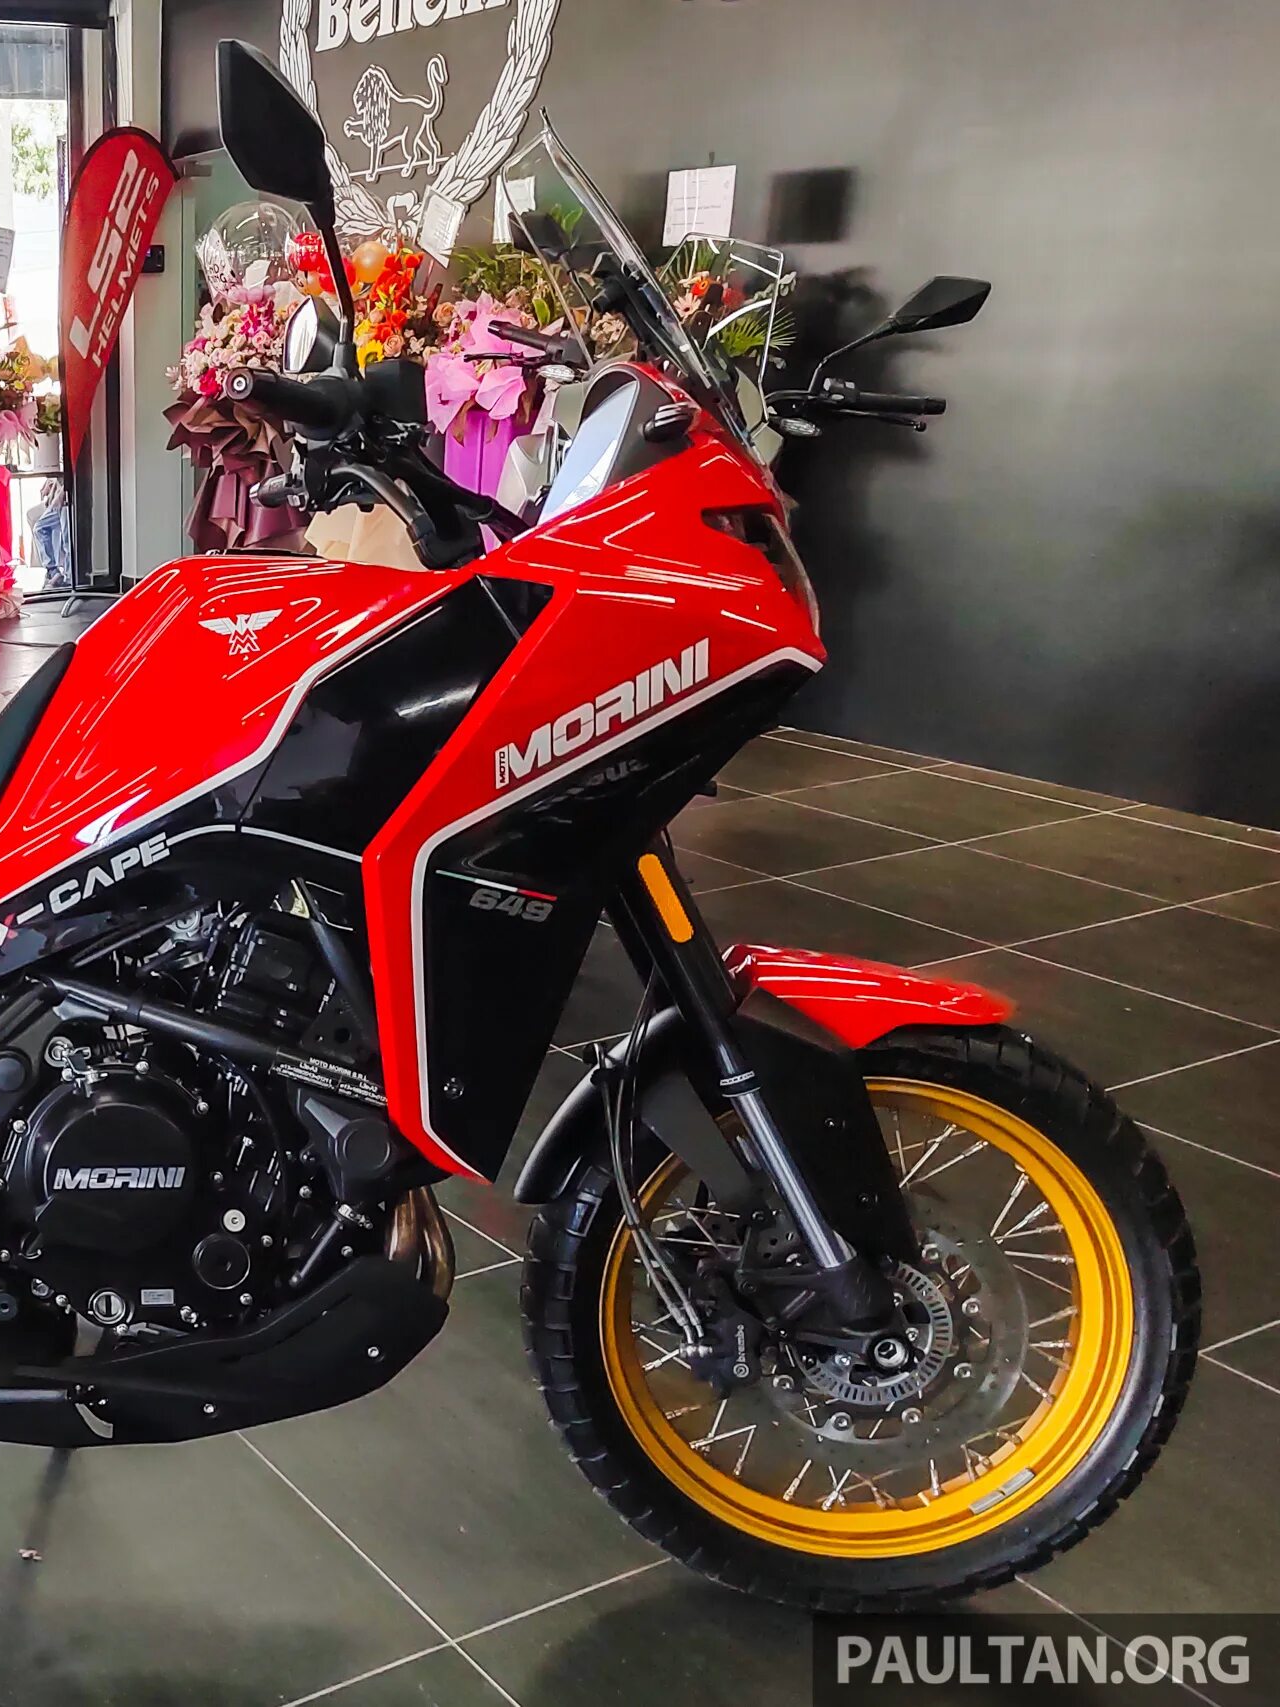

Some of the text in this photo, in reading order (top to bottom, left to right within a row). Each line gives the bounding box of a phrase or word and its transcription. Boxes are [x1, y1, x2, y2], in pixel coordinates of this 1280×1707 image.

[315, 0, 506, 52] Bene
[69, 149, 147, 360] LS2
[91, 171, 160, 368] HELMETS
[498, 637, 709, 784] MOTO MORINI
[469, 888, 554, 922] 649
[309, 1057, 328, 1068] MOTO
[328, 1063, 352, 1077] MORINI
[63, 1167, 185, 1190] MORINI
[735, 1324, 746, 1362] brembo
